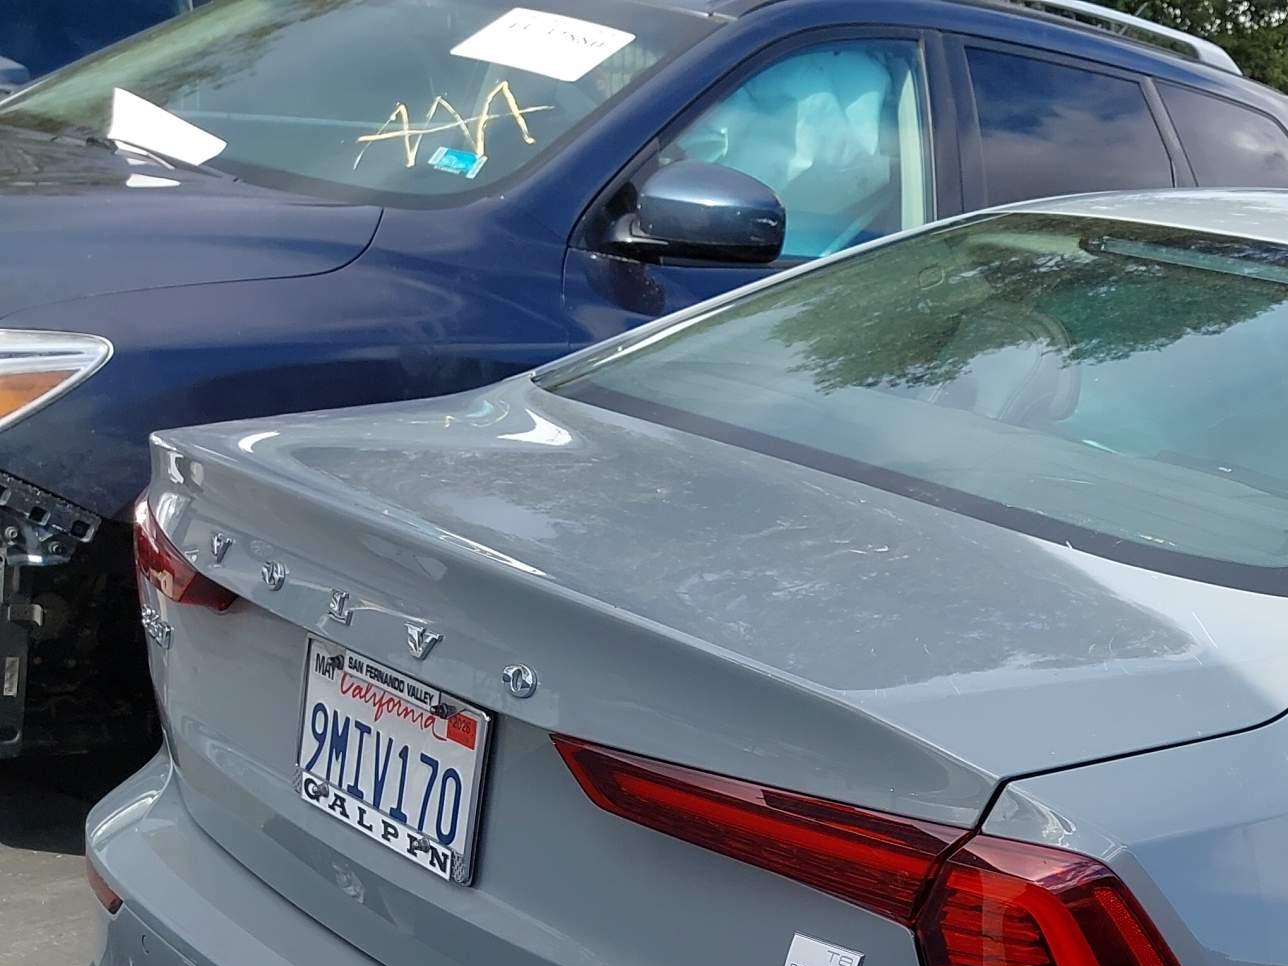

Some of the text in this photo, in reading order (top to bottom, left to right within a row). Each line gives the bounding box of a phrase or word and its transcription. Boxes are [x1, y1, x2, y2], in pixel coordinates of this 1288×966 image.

[210, 532, 539, 698] VOLVO
[315, 653, 338, 680] MAY
[348, 656, 435, 706] SAN FERNANDO VALLEY
[340, 672, 447, 741] California
[452, 714, 472, 734] 2026
[305, 702, 463, 846] 9MIV170
